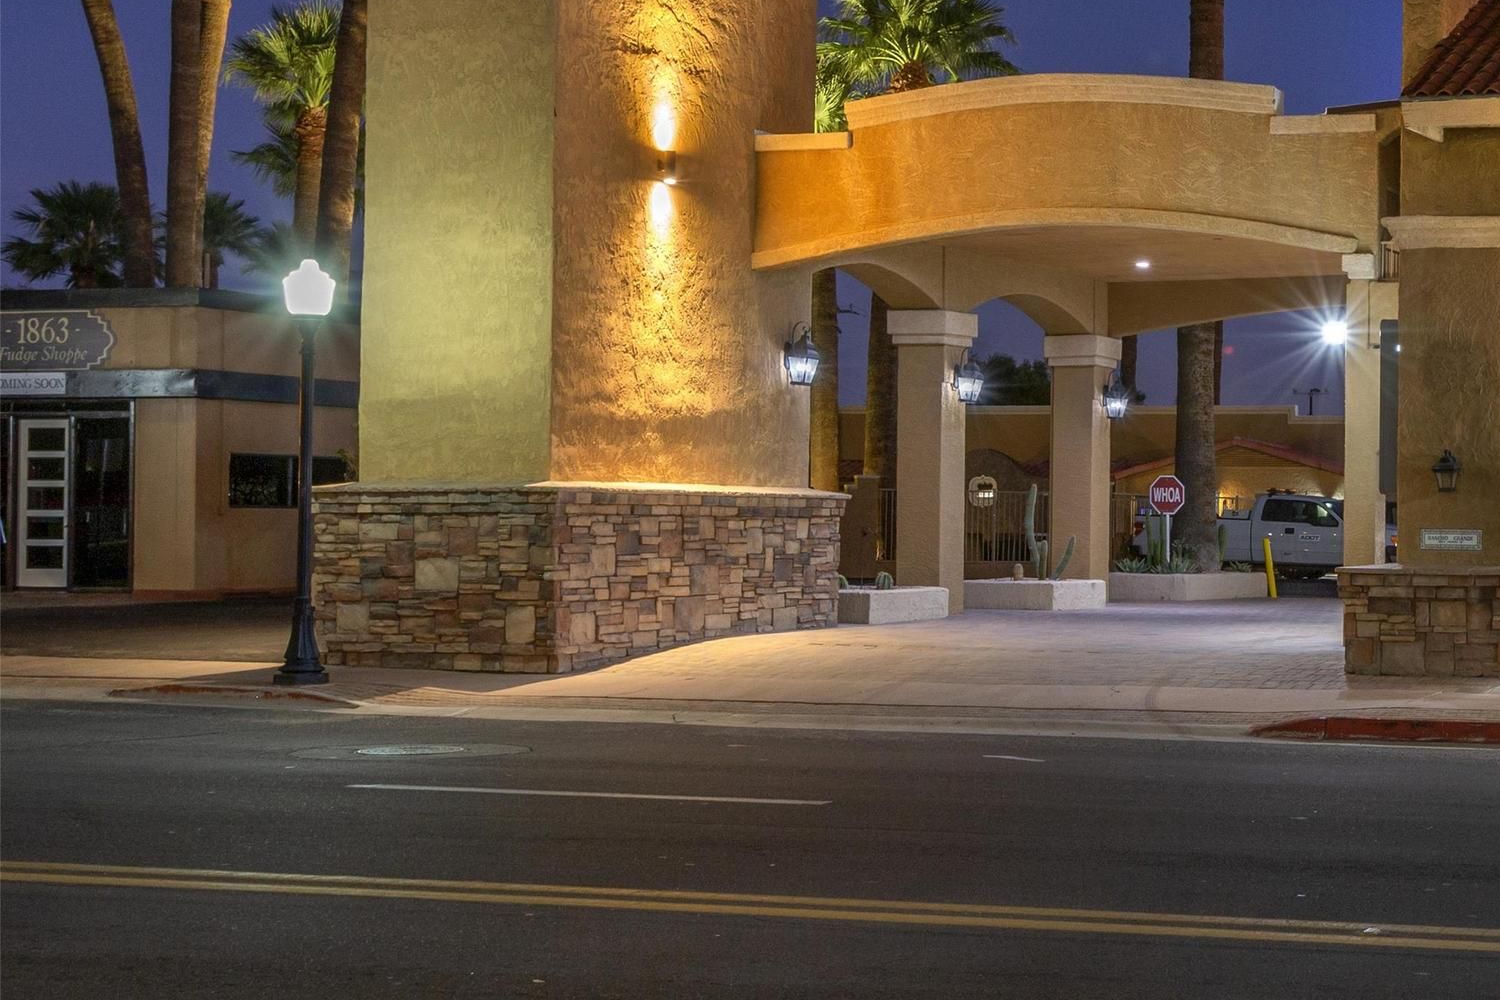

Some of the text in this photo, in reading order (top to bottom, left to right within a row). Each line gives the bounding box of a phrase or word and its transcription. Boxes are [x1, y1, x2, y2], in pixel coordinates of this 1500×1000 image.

[17, 317, 69, 344] 1863
[0, 345, 88, 364] Fudge Shoppe
[33, 378, 65, 389] SOON
[1153, 487, 1181, 503] WHOA
